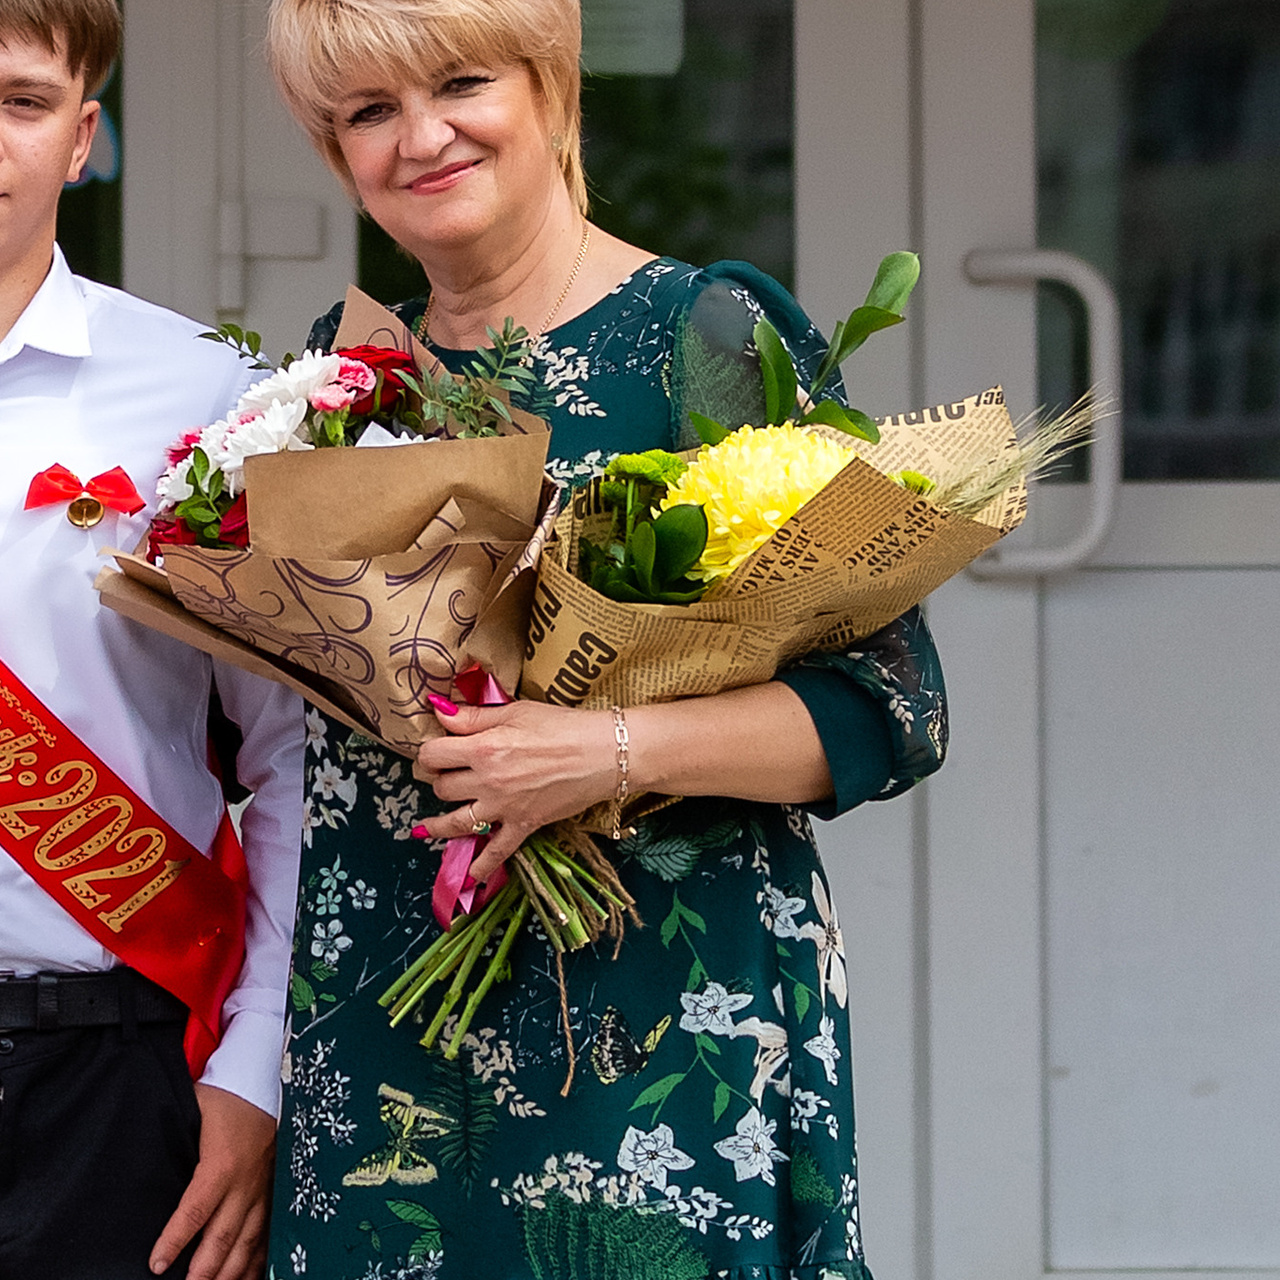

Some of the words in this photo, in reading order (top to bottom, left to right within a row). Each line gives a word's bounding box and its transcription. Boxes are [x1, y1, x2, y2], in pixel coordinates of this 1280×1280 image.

[902, 505, 940, 537] ERS
[903, 499, 928, 523] OF
[769, 527, 794, 554] OF
[842, 521, 902, 571] MAGIC
[866, 536, 901, 567] AND
[736, 553, 776, 595] MAG
